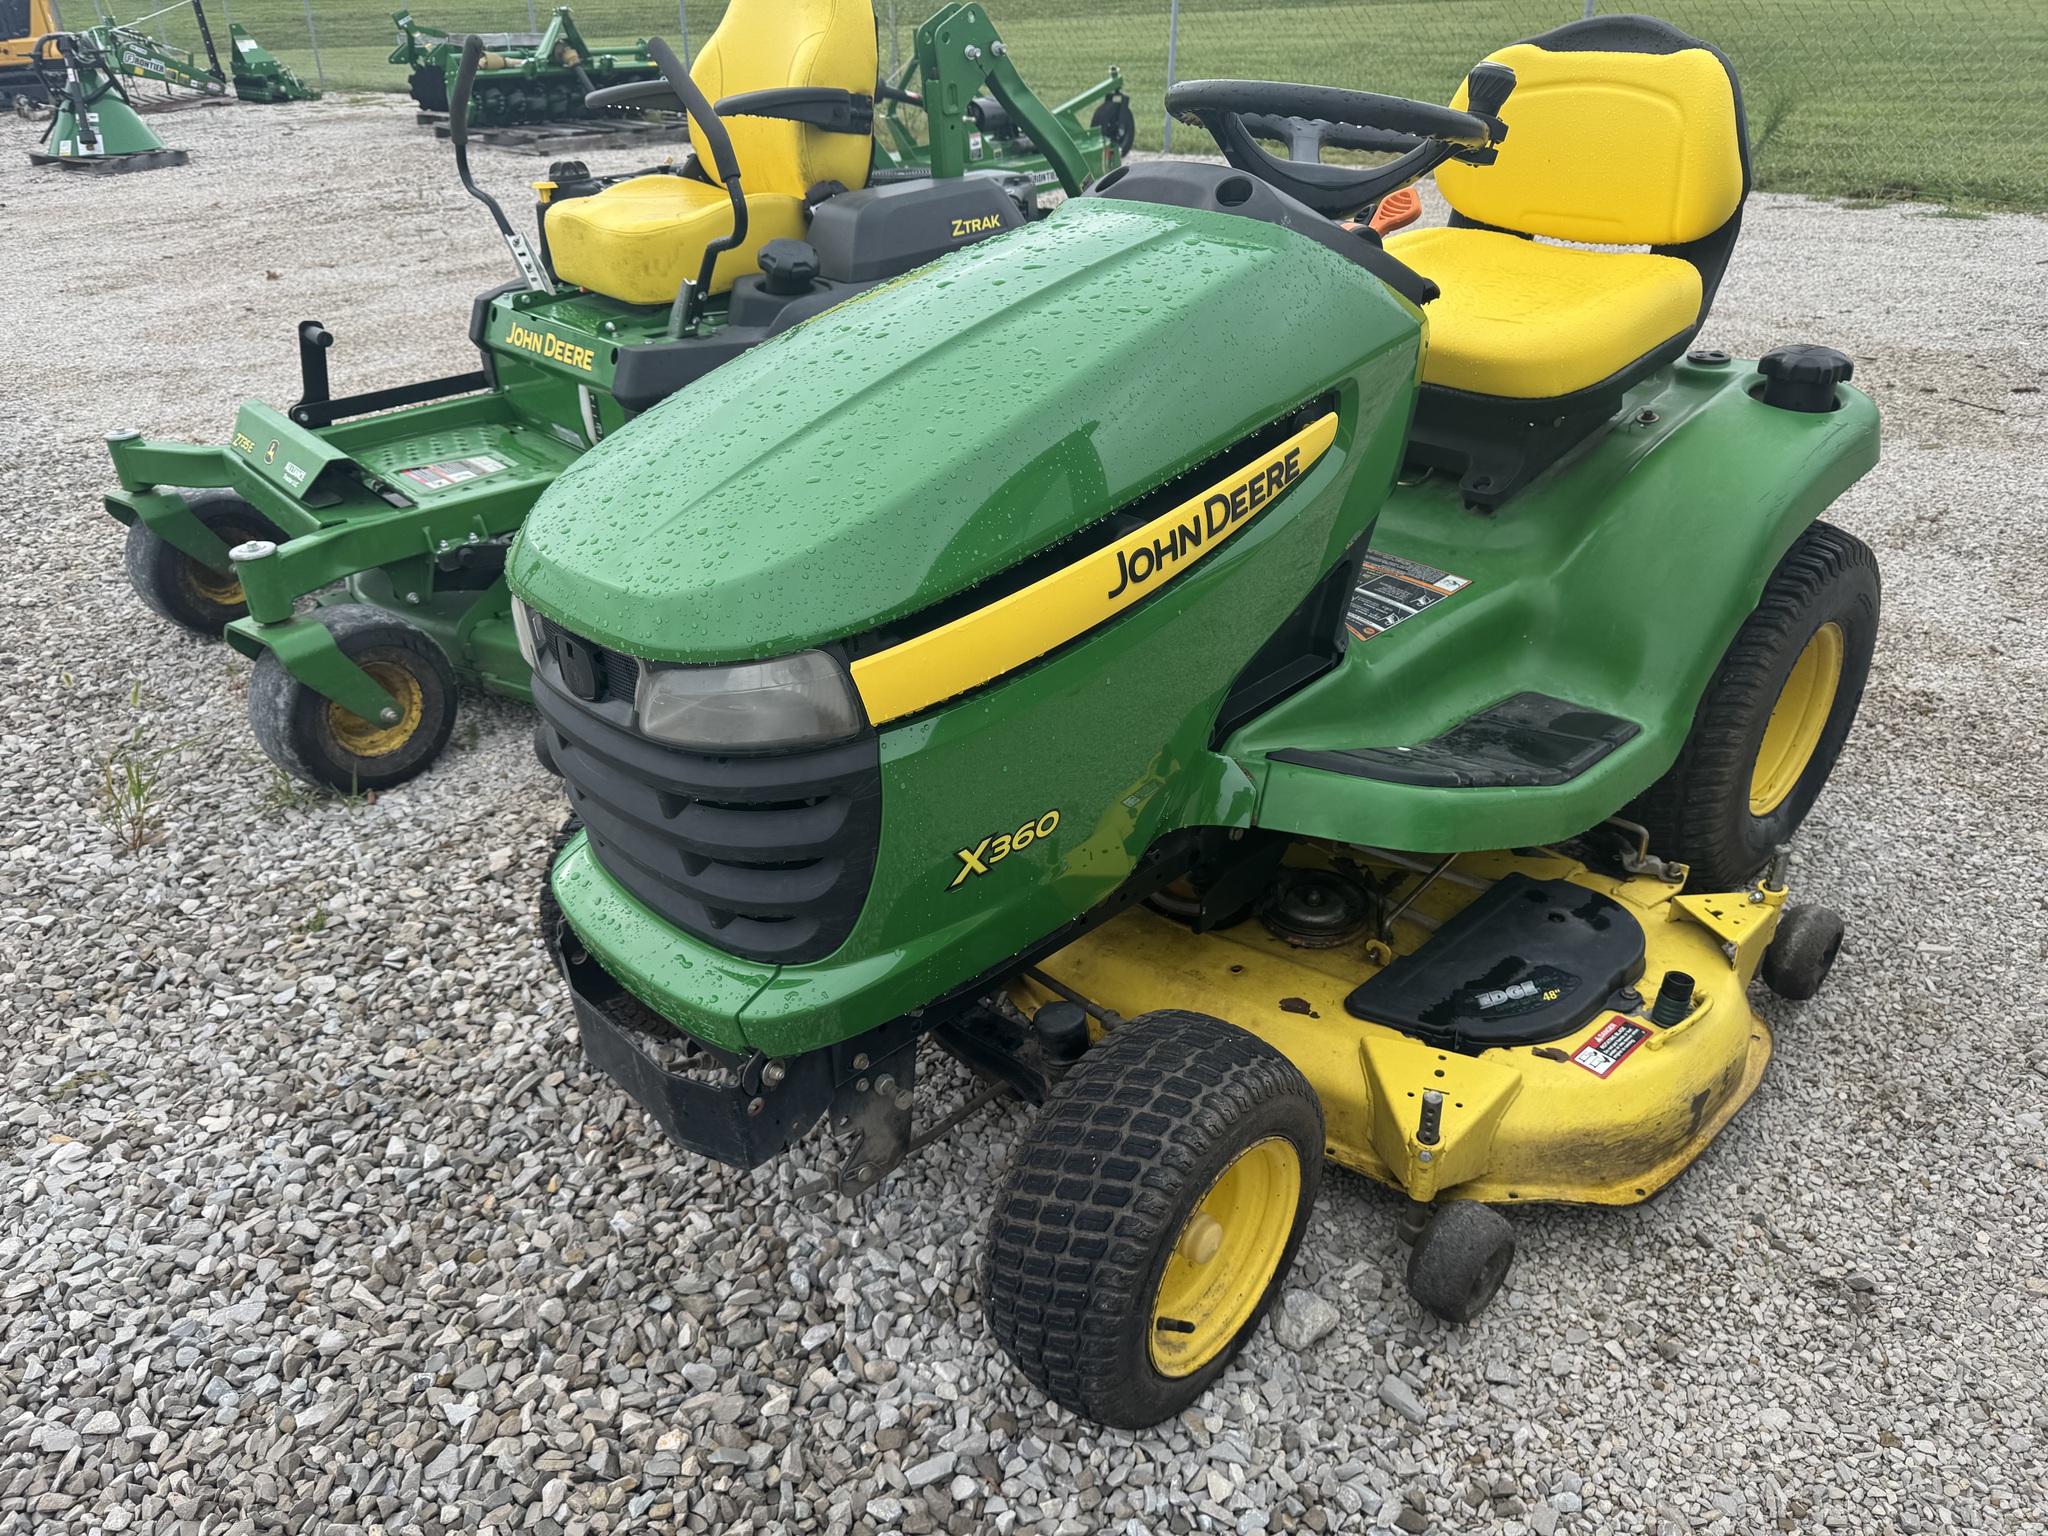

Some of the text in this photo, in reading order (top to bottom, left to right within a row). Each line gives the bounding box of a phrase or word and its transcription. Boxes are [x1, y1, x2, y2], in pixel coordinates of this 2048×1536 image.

[951, 213, 1002, 237] ZTRAK
[505, 321, 595, 372] JOHN DEERE
[1108, 446, 1301, 600] JOHN DEERE
[945, 808, 1061, 890] X360
[1475, 980, 1539, 1010] EDGE
